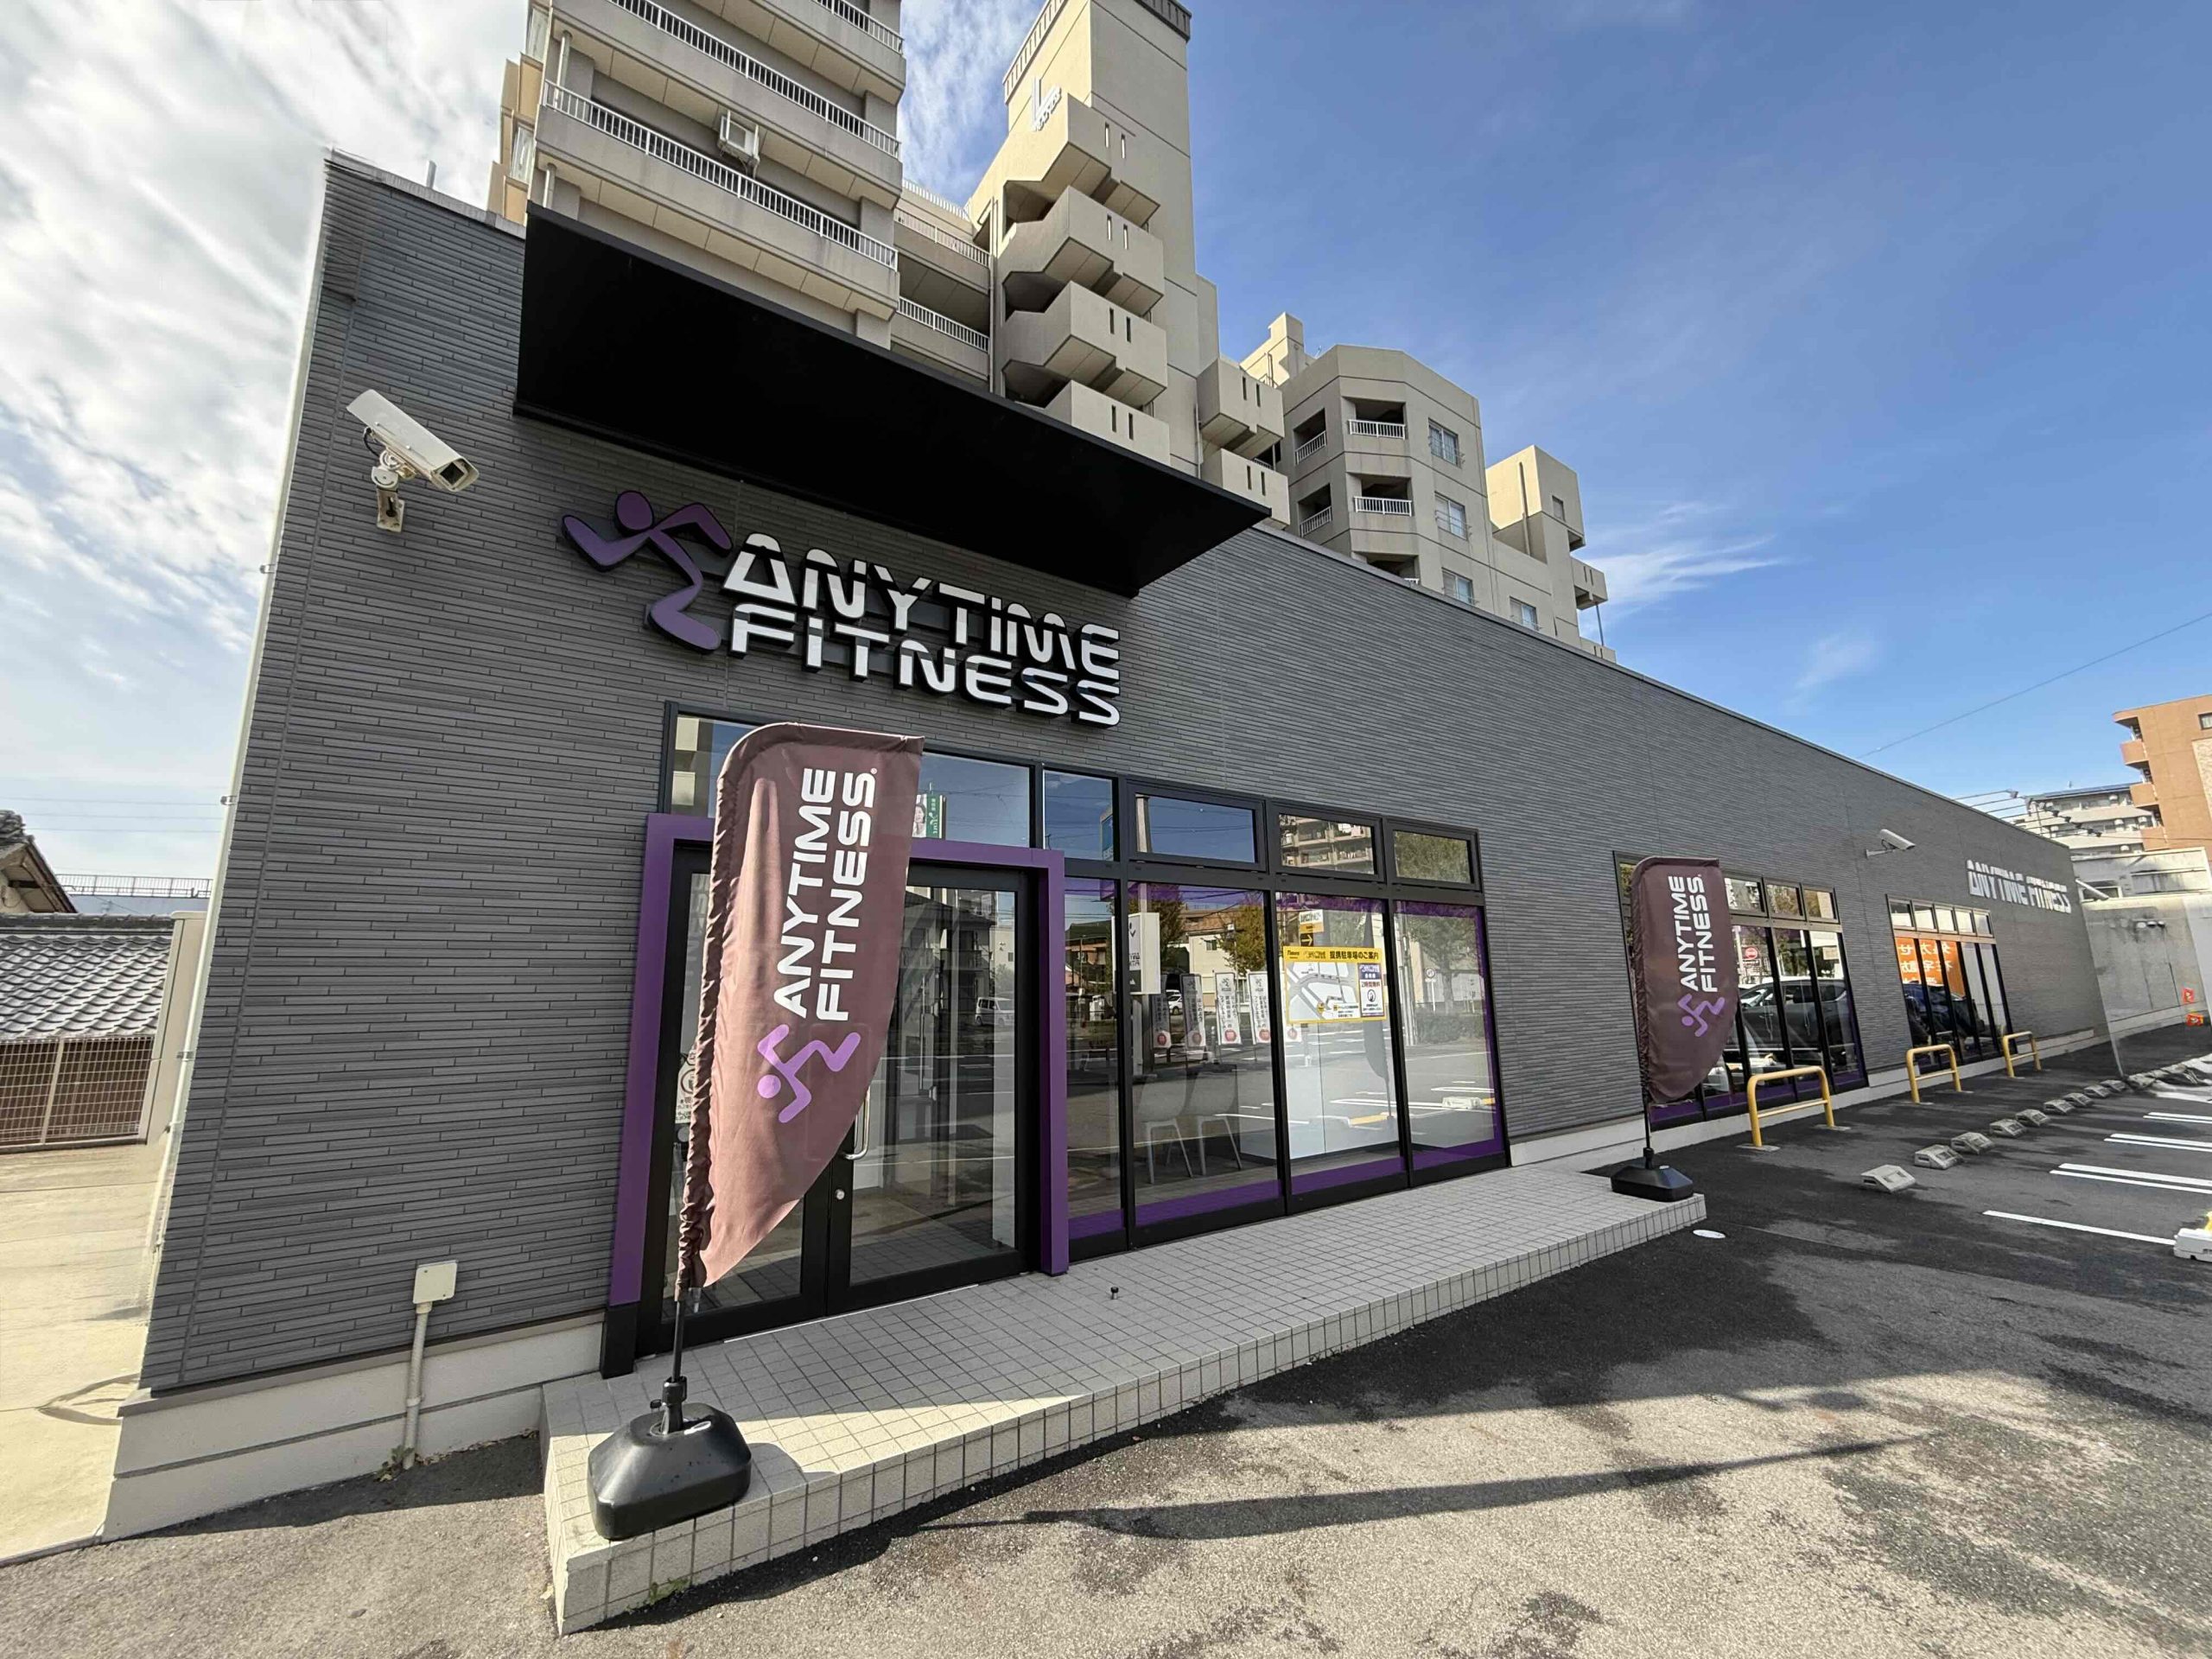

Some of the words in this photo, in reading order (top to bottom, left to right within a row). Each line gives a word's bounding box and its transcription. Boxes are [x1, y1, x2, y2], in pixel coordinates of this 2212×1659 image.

[722, 532, 1120, 680] ANYTIME
[729, 604, 1121, 728] FITNESS
[773, 768, 836, 1020] ANYTIME
[816, 771, 875, 1021] FITNESS
[1668, 875, 1700, 991] ANYTIME
[1687, 875, 1719, 993] FITNESS
